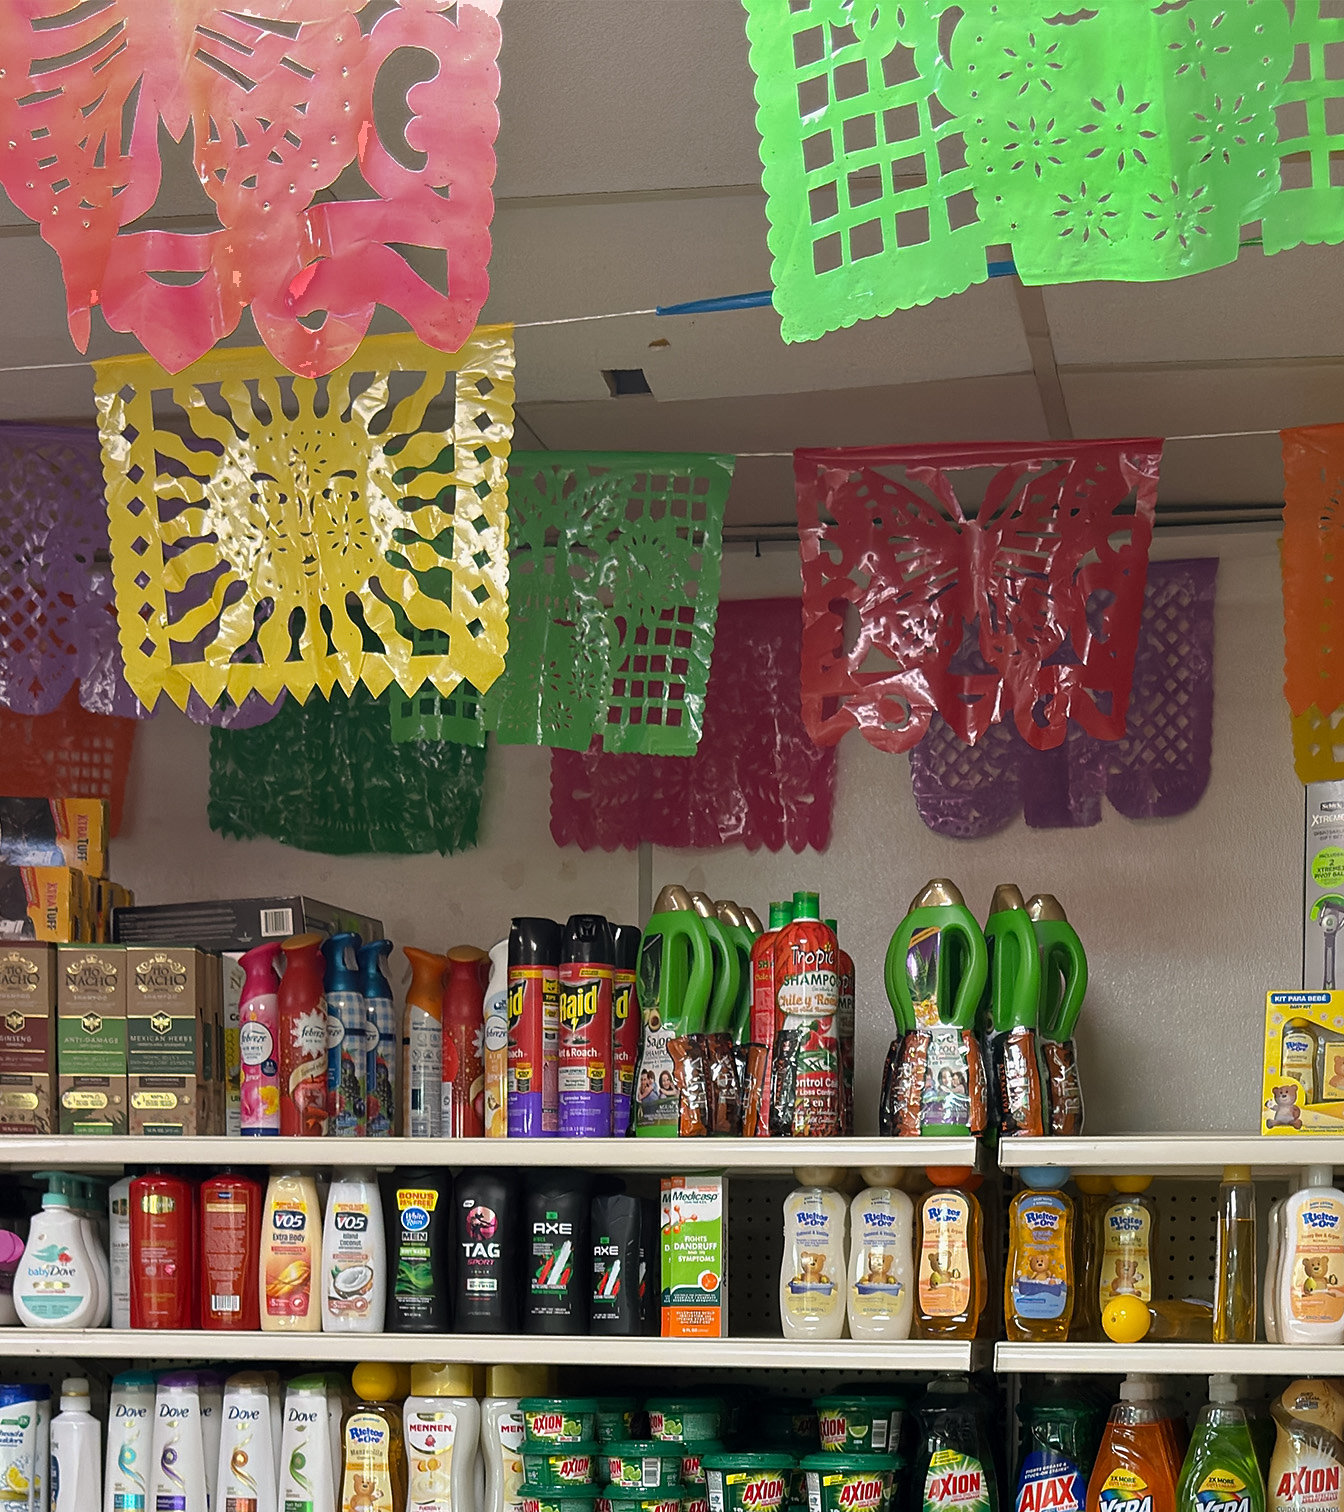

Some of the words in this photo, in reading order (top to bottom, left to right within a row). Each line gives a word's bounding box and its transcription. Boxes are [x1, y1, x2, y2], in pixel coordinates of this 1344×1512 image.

[792, 945, 833, 971] Tropic
[66, 973, 117, 987] NACHO
[134, 973, 186, 986] NACHO
[560, 986, 598, 1023] Raid
[571, 1048, 597, 1057] Roach
[803, 1099, 811, 1107] 2
[398, 1192, 434, 1200] BONUS
[672, 1191, 719, 1203] Medicasp
[273, 1214, 306, 1230] VO5
[334, 1215, 367, 1230] VO5
[1302, 1212, 1339, 1225] Ricitos
[533, 1223, 572, 1234] AXE
[273, 1233, 291, 1242] Extra
[292, 1234, 305, 1242] Body
[403, 1232, 427, 1242] MEN
[462, 1243, 500, 1258] TAG
[594, 1246, 619, 1255] AXE
[116, 1405, 149, 1418] Dove
[160, 1405, 190, 1418] Dove
[229, 1407, 261, 1421] Dove
[289, 1410, 319, 1423] Dove
[531, 1415, 564, 1433] AXION
[559, 1458, 590, 1477] AXION
[927, 1472, 982, 1501] AXION
[1276, 1466, 1340, 1502] AXION
[743, 1479, 786, 1504] AXION
[839, 1481, 883, 1504] AXION
